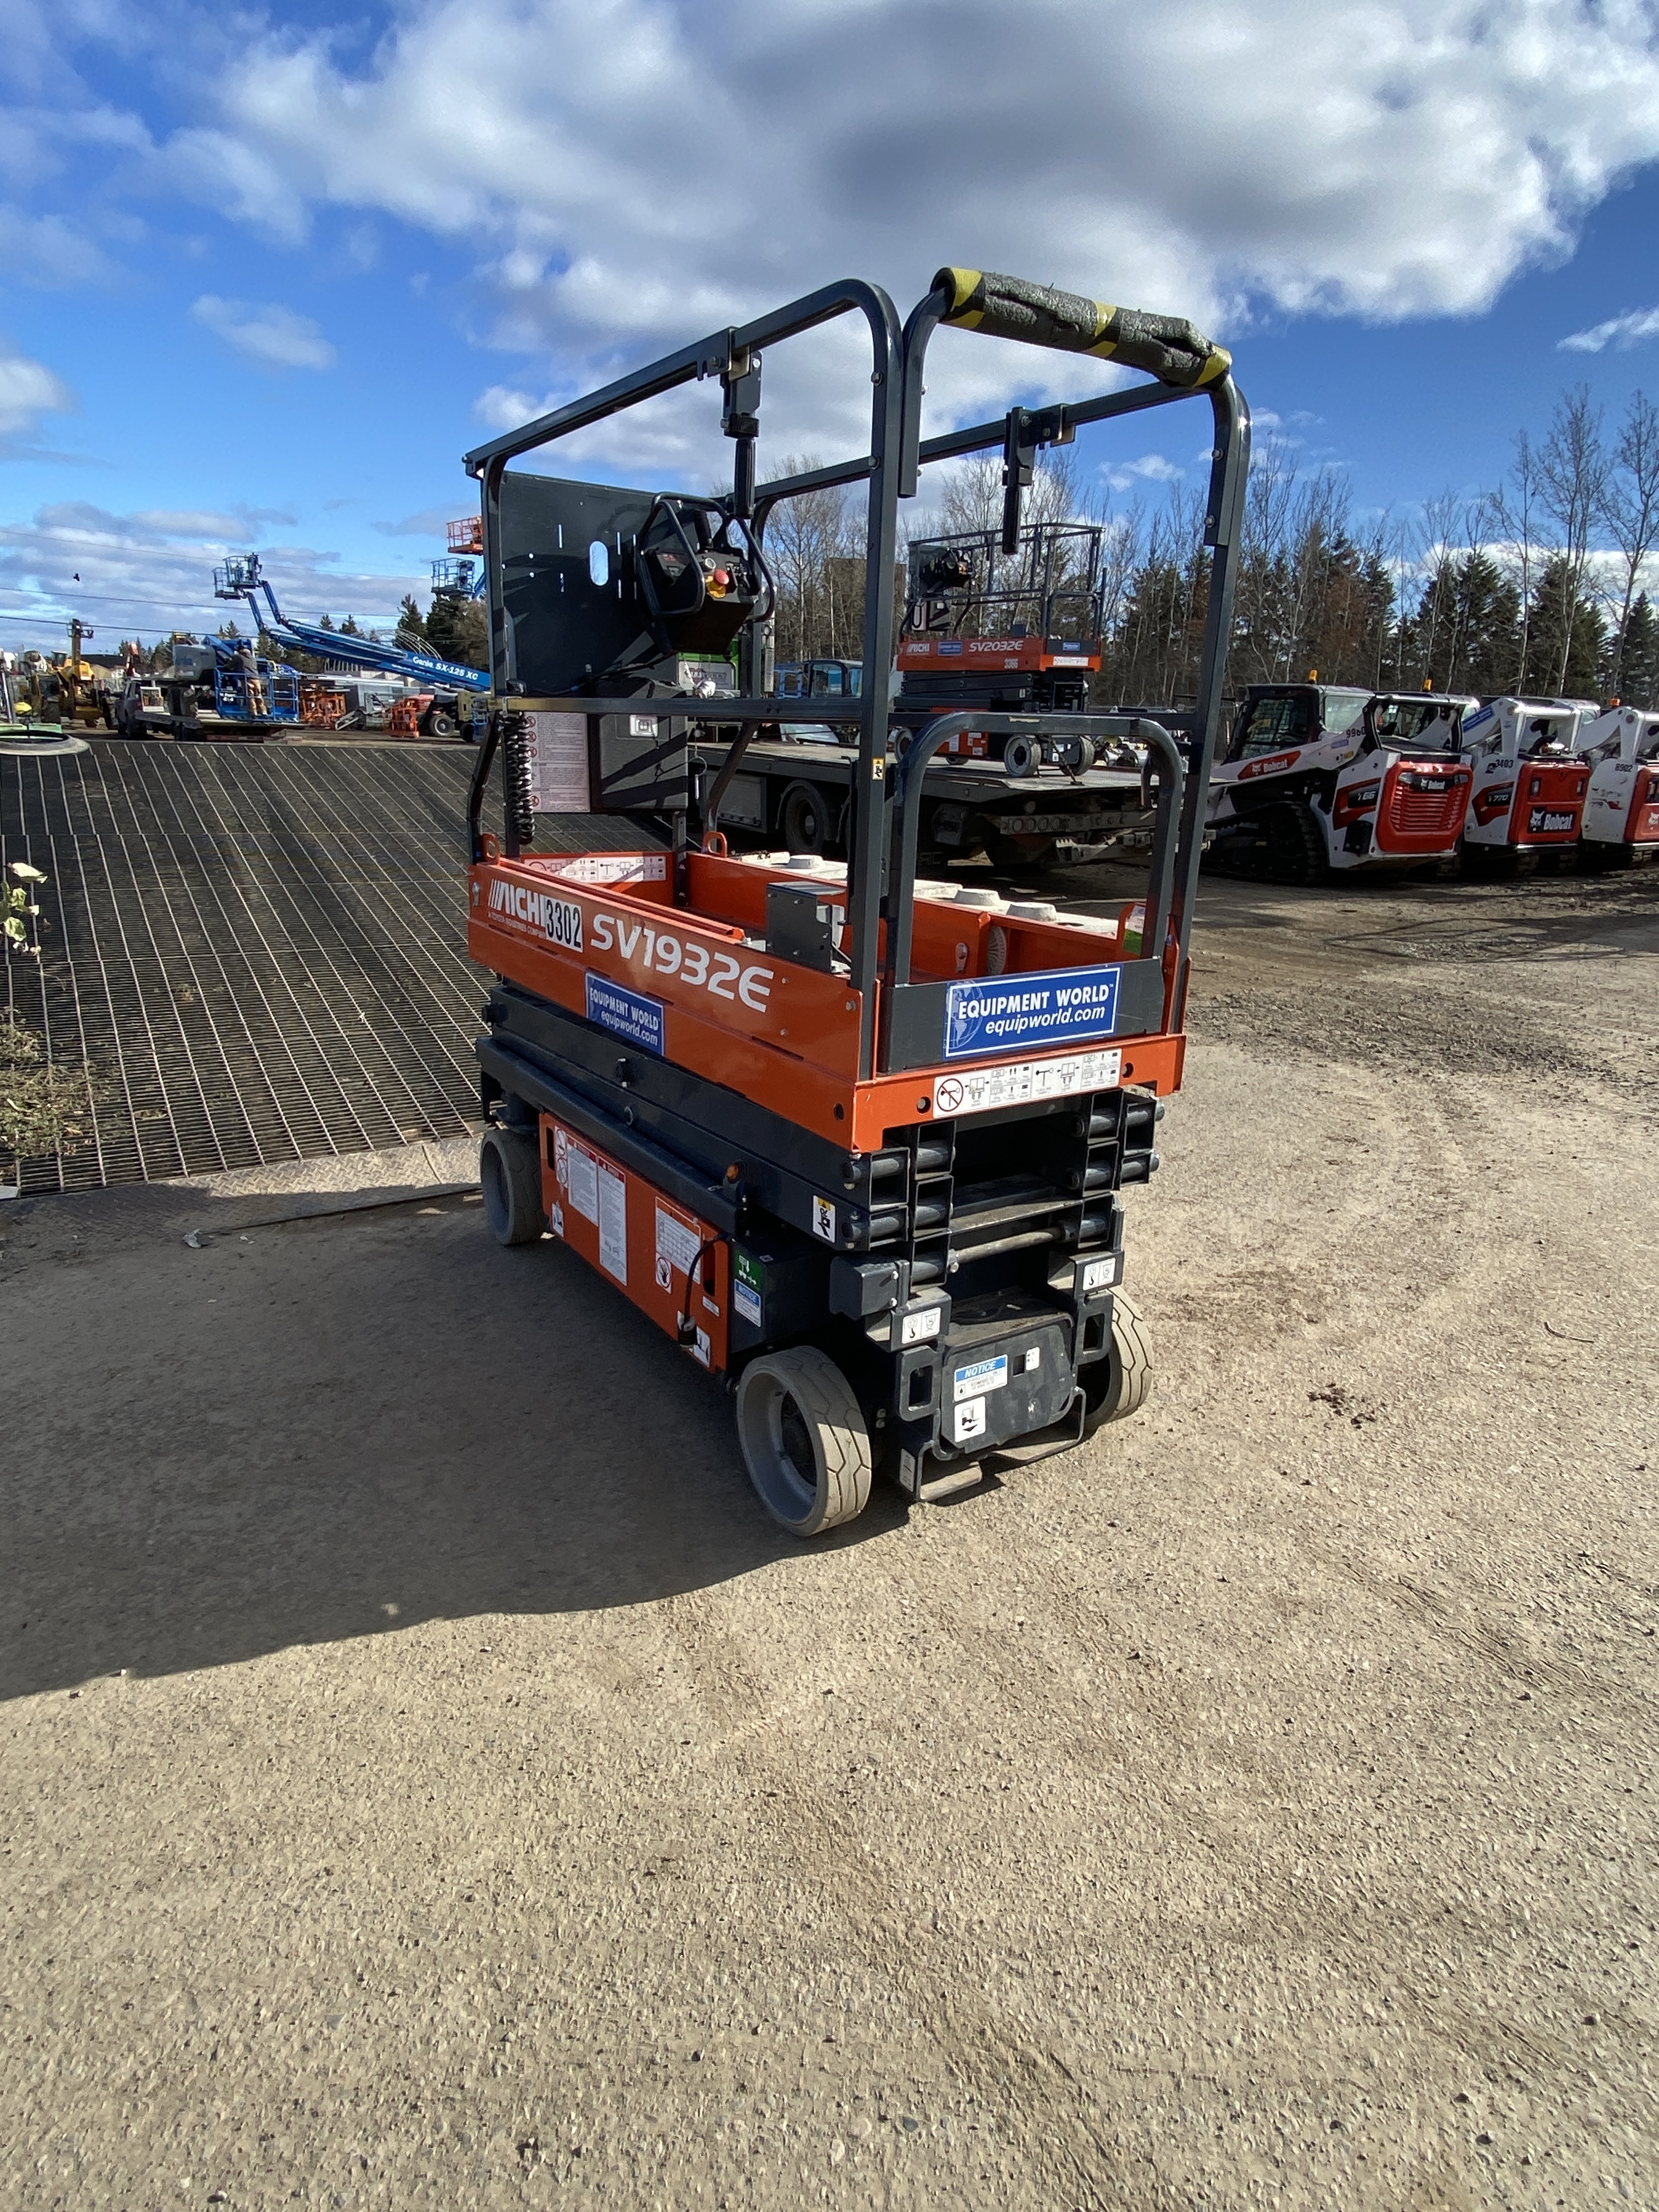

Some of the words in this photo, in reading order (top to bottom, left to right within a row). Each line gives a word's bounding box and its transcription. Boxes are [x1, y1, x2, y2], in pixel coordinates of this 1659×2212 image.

[968, 640, 1024, 653] SV2032E
[413, 656, 434, 669] Genie
[436, 663, 465, 677] SX-125
[466, 671, 479, 680] XC
[1263, 759, 1288, 772] Bobcat
[1496, 759, 1514, 768] 3403
[1543, 814, 1573, 831] Bobcat
[488, 878, 546, 928] AICHI
[546, 899, 582, 949] 3302
[590, 913, 775, 1013] SV1932E
[589, 988, 629, 1017] EQUIPMENT
[631, 1006, 659, 1031] WORLD
[958, 991, 1050, 1020] EQUIPMENT
[1056, 984, 1109, 1007] WORLD
[601, 1011, 658, 1046] equipworld.com
[985, 1006, 1105, 1036] equipworld.com
[964, 1361, 997, 1378] NOTICE
